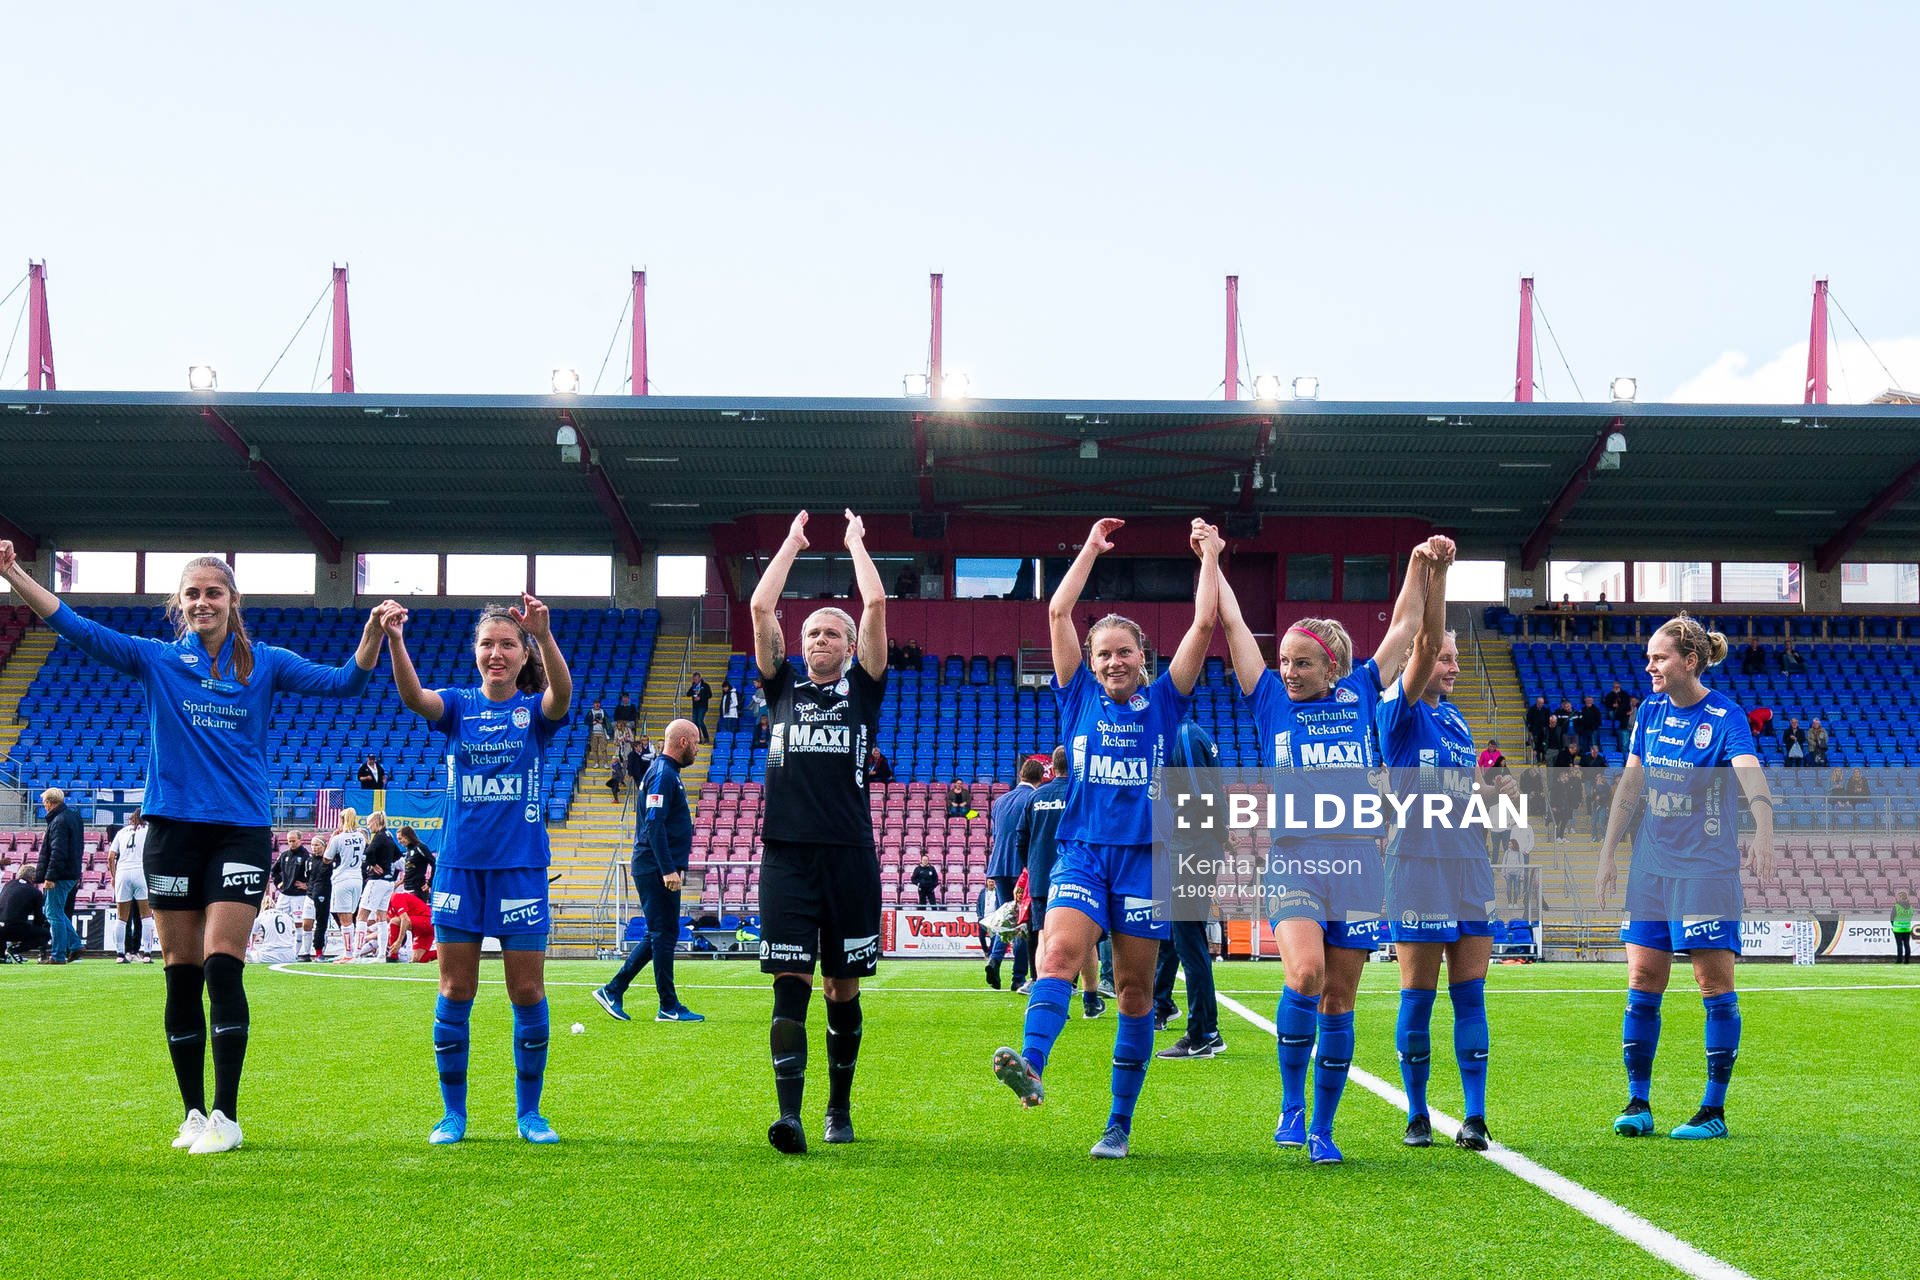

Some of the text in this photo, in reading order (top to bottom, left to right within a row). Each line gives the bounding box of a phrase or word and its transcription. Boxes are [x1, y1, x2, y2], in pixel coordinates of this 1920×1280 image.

[1378, 612, 1386, 621] C
[183, 700, 248, 717] Sparbanken
[192, 715, 237, 730] Rekarne
[800, 712, 842, 722] Rekarne
[1296, 709, 1359, 725] Sparbanken
[789, 725, 850, 746] MAXI
[1307, 725, 1354, 736] Rekarne
[461, 739, 523, 754] Sparbanken
[1301, 743, 1364, 765] MAXI
[471, 754, 515, 765] Rekarne
[1089, 755, 1148, 779] MAXI
[1646, 752, 1694, 769] Sparbanken
[1649, 766, 1685, 782] Rekarne
[462, 775, 522, 796] MAXI
[350, 846, 360, 868] 5
[223, 874, 261, 888] ACTIC
[502, 905, 539, 925] ACTIC
[1125, 907, 1162, 923] ACTIC
[274, 915, 286, 934] 6
[1684, 920, 1721, 938] ACTIC
[771, 952, 792, 961] Energi
[846, 941, 878, 964] ACTIC
